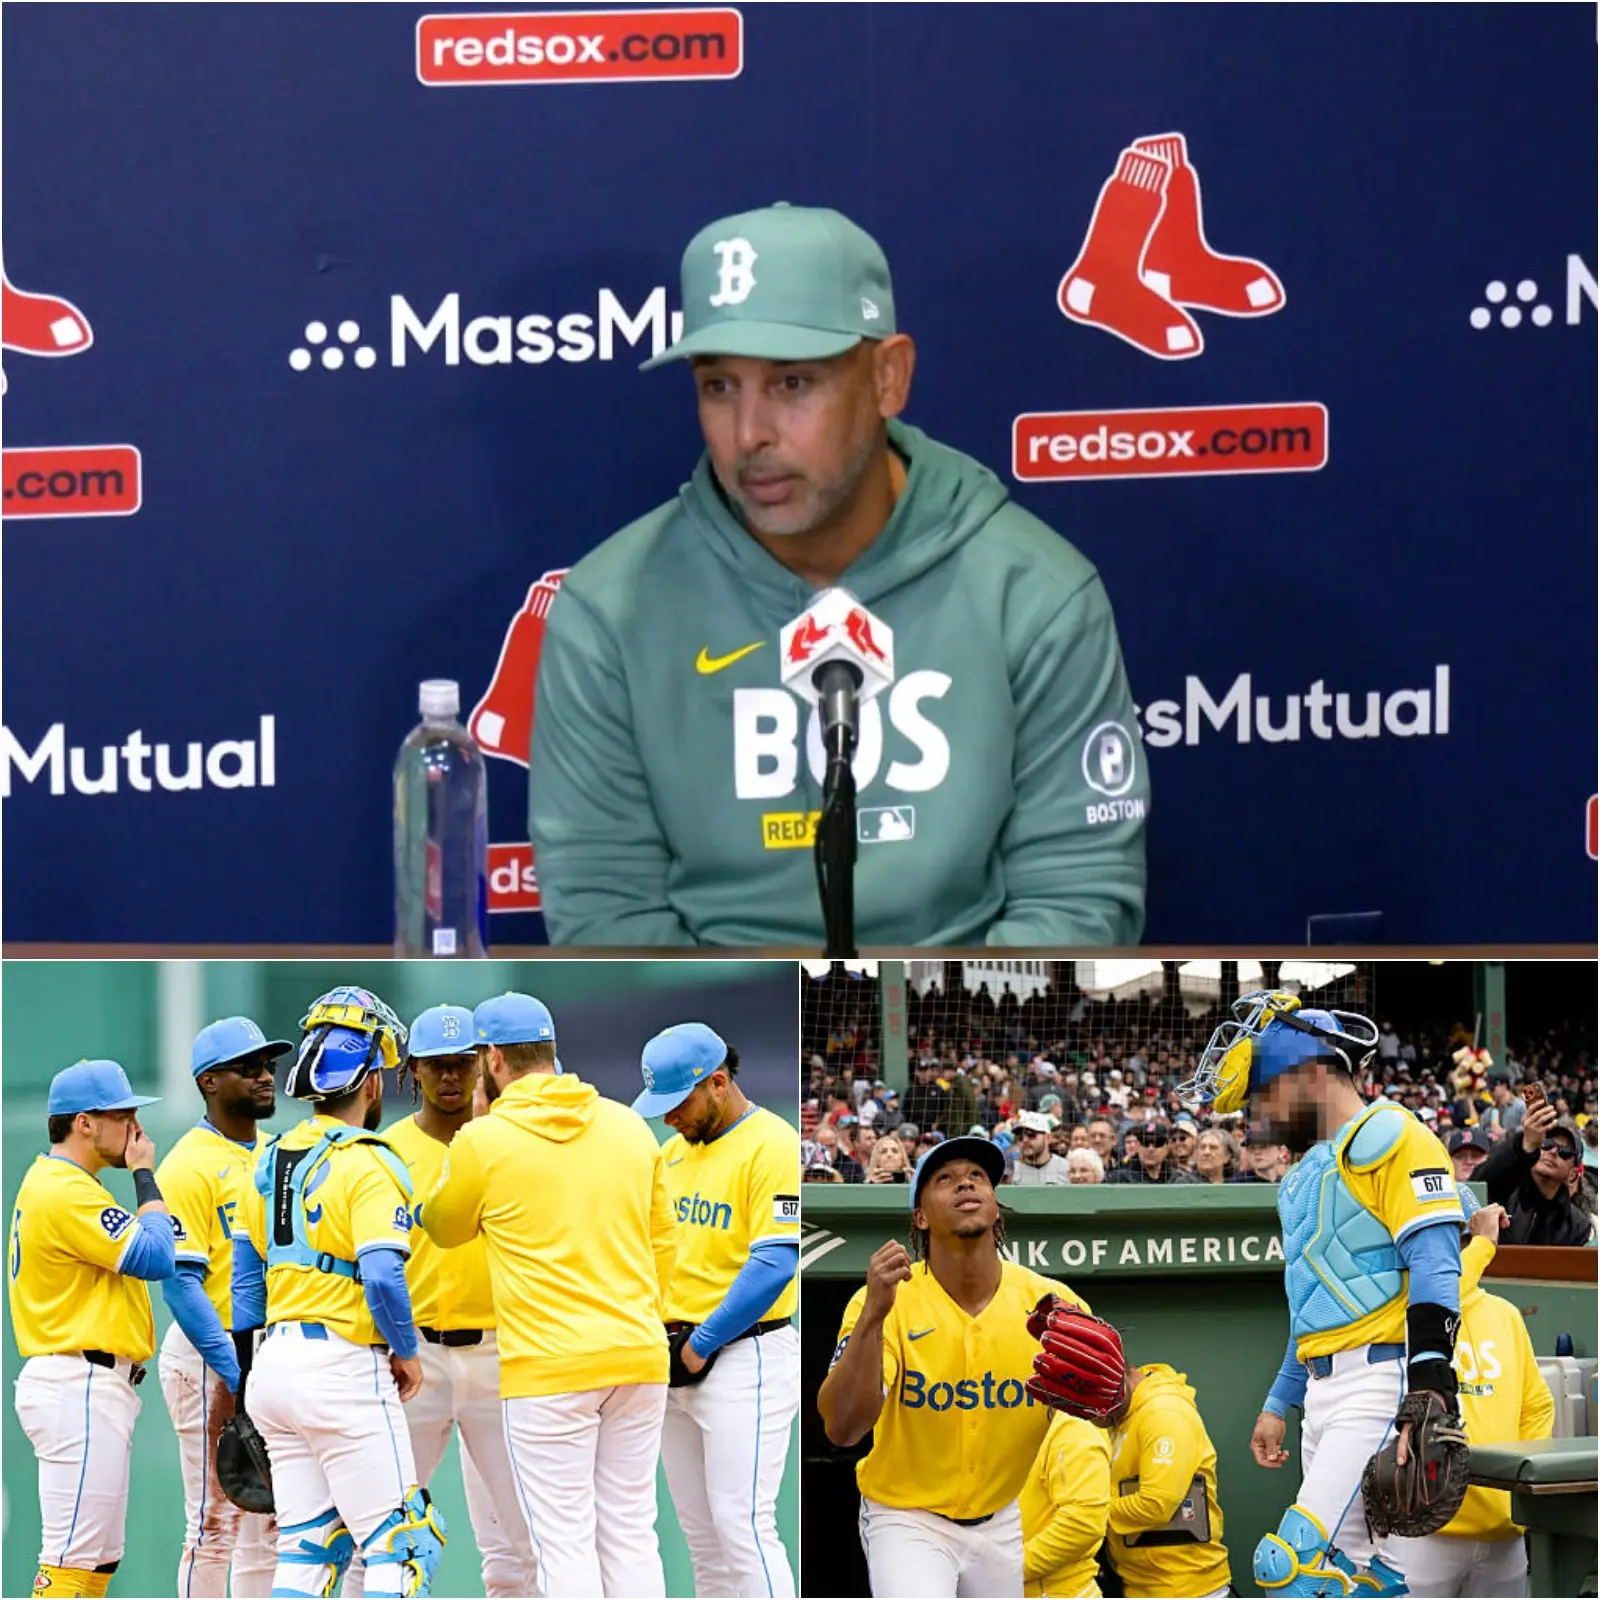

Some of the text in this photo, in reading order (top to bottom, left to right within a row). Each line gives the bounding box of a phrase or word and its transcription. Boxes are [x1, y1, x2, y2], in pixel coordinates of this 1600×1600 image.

[433, 28, 726, 67] redsox.com
[709, 237, 758, 308] B
[1029, 424, 1311, 463] redsox.com
[733, 669, 953, 800] BOS
[2, 715, 275, 797] Mutual
[767, 819, 807, 840] RED
[1086, 799, 1145, 825] BOSTON
[1423, 1175, 1444, 1193] 617
[673, 1190, 733, 1230] ston
[782, 1202, 799, 1216] 617
[1061, 1238, 1109, 1267] OF
[1118, 1235, 1286, 1266] AMERICA
[1449, 1340, 1502, 1380] OS
